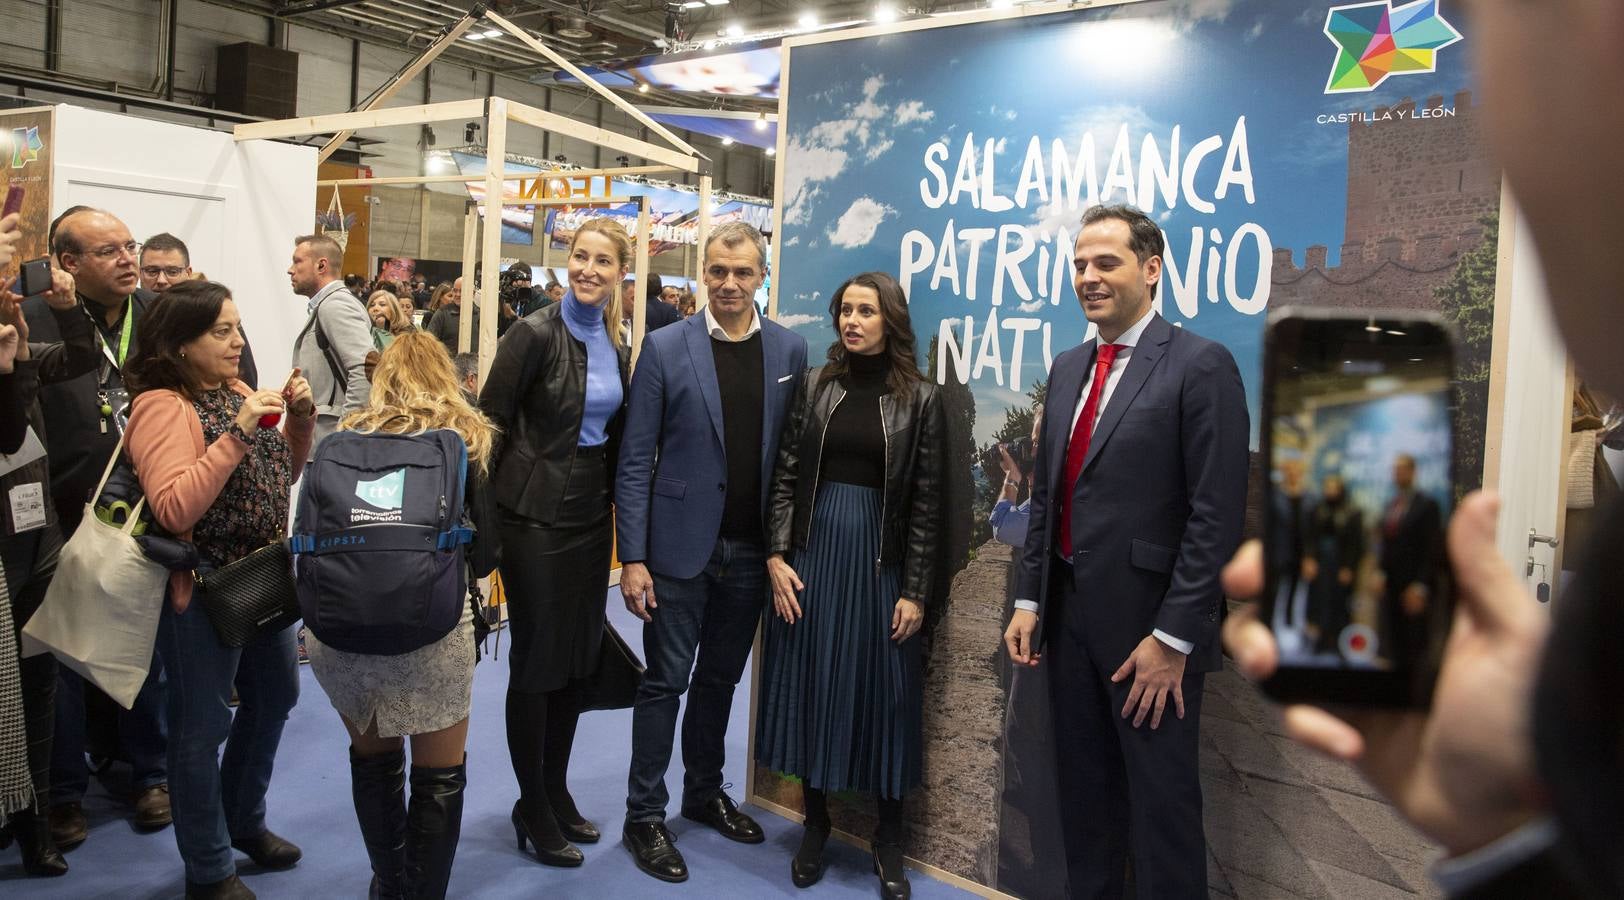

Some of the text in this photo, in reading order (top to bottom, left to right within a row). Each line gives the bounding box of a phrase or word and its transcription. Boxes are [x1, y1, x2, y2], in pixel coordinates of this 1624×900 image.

[1316, 104, 1456, 124] CASTILLA Y LEÓN
[919, 115, 1255, 213] SALAMANCA
[900, 219, 1273, 319] PATRiNiO
[369, 485, 398, 498] ttv
[351, 508, 402, 516] torremolinos
[351, 513, 402, 522] televisión
[320, 536, 366, 549] KIPSTA
